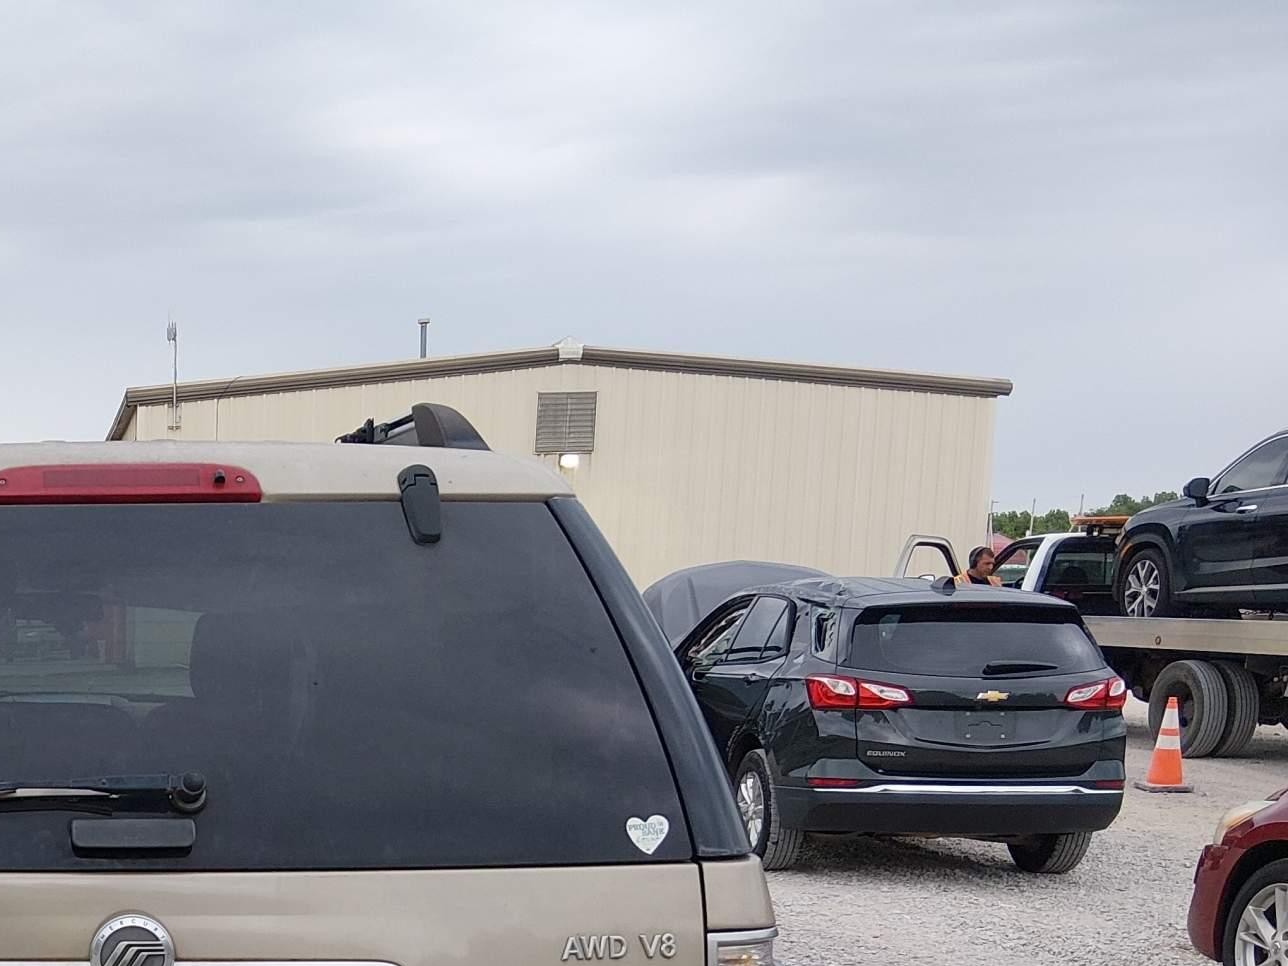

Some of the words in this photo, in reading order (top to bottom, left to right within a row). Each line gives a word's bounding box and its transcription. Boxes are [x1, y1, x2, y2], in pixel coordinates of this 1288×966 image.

[98, 918, 166, 941] MERCURY
[562, 934, 628, 961] AWD
[639, 932, 677, 959] V8
